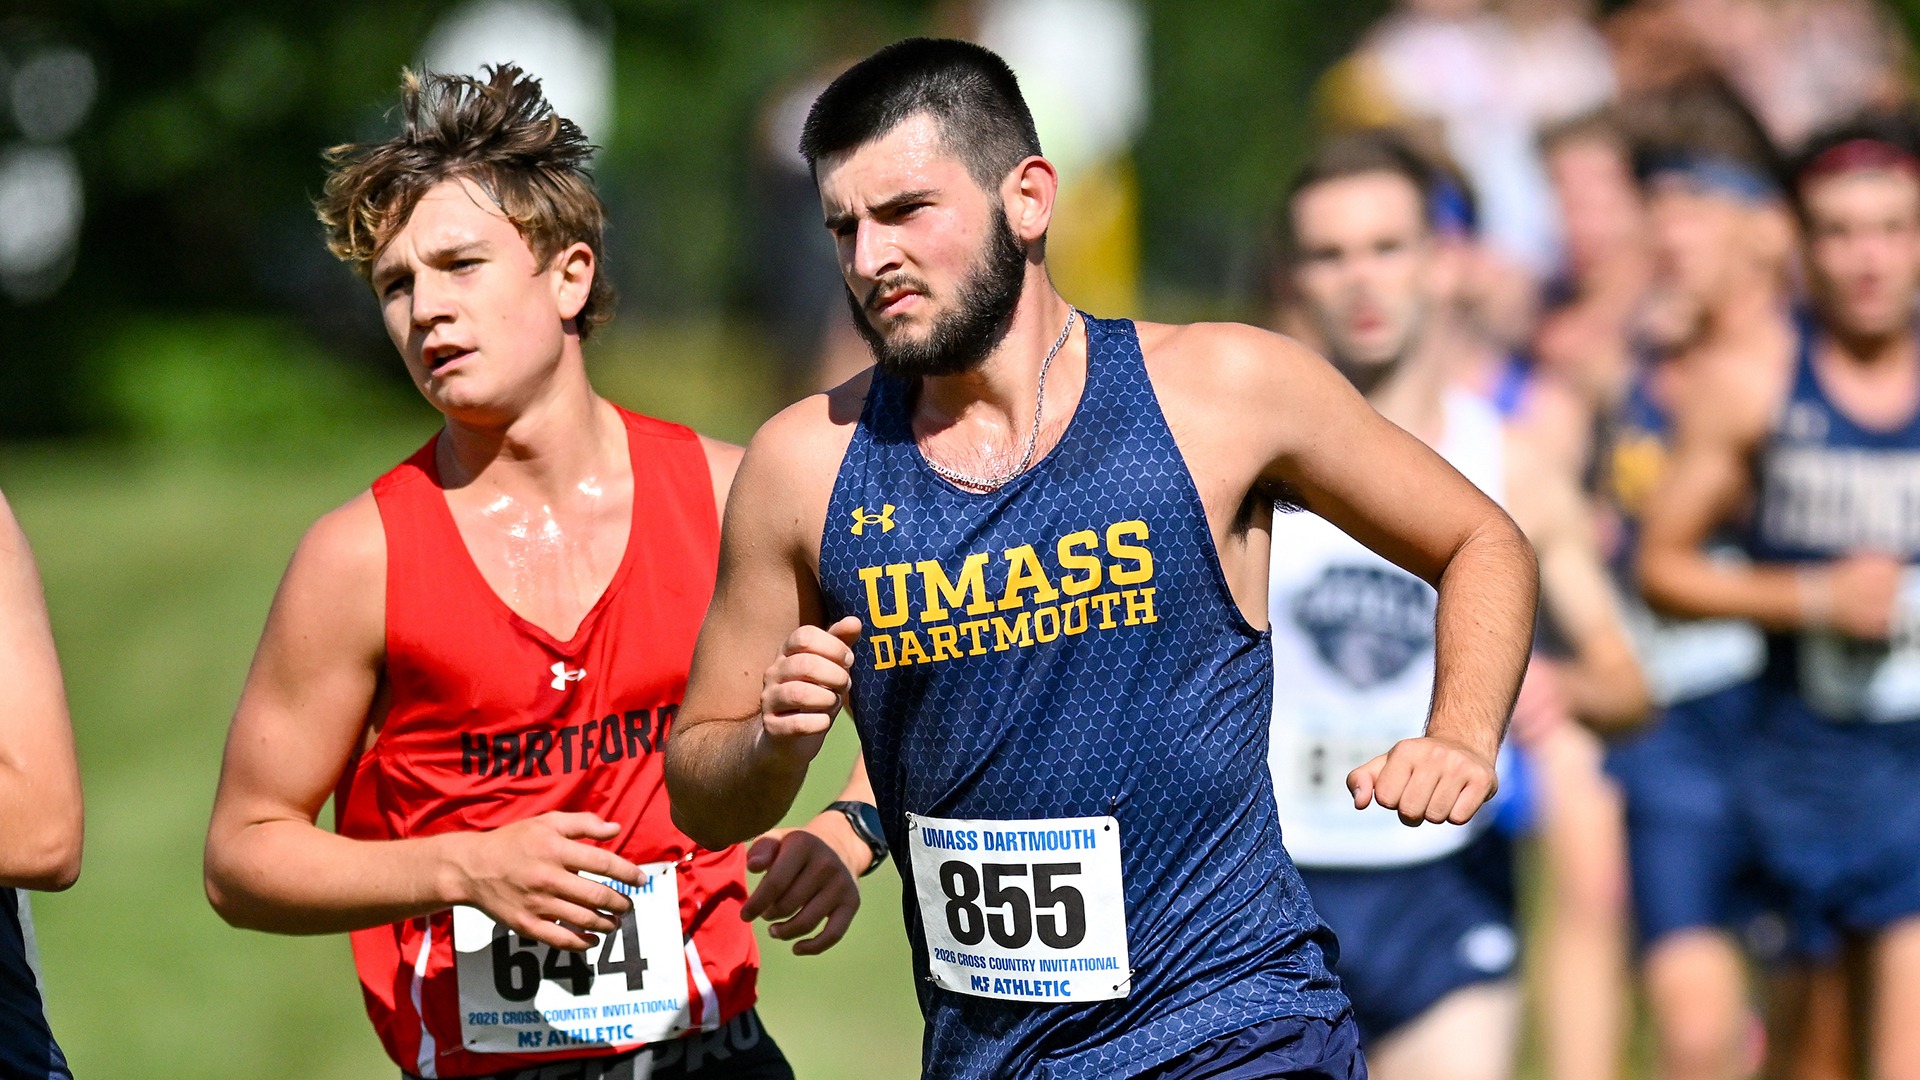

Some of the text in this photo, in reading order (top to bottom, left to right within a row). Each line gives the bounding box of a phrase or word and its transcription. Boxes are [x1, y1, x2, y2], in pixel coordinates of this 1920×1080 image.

[858, 519, 1154, 629] UMASS
[870, 587, 1158, 670] DARTMOUTH
[461, 703, 680, 777] HARTFORD
[922, 827, 1096, 851] UMASS DARTMOUTH
[939, 860, 1086, 949] 855
[492, 900, 648, 1002] 644
[934, 947, 1120, 972] 2026 CROSS COUNTRY INVITATIONAL
[469, 998, 681, 1025] 2026 CROSS COUNTRY INVITATIONAL
[994, 978, 1071, 997] ATHLETIC
[547, 1024, 633, 1047] ATHLETIC
